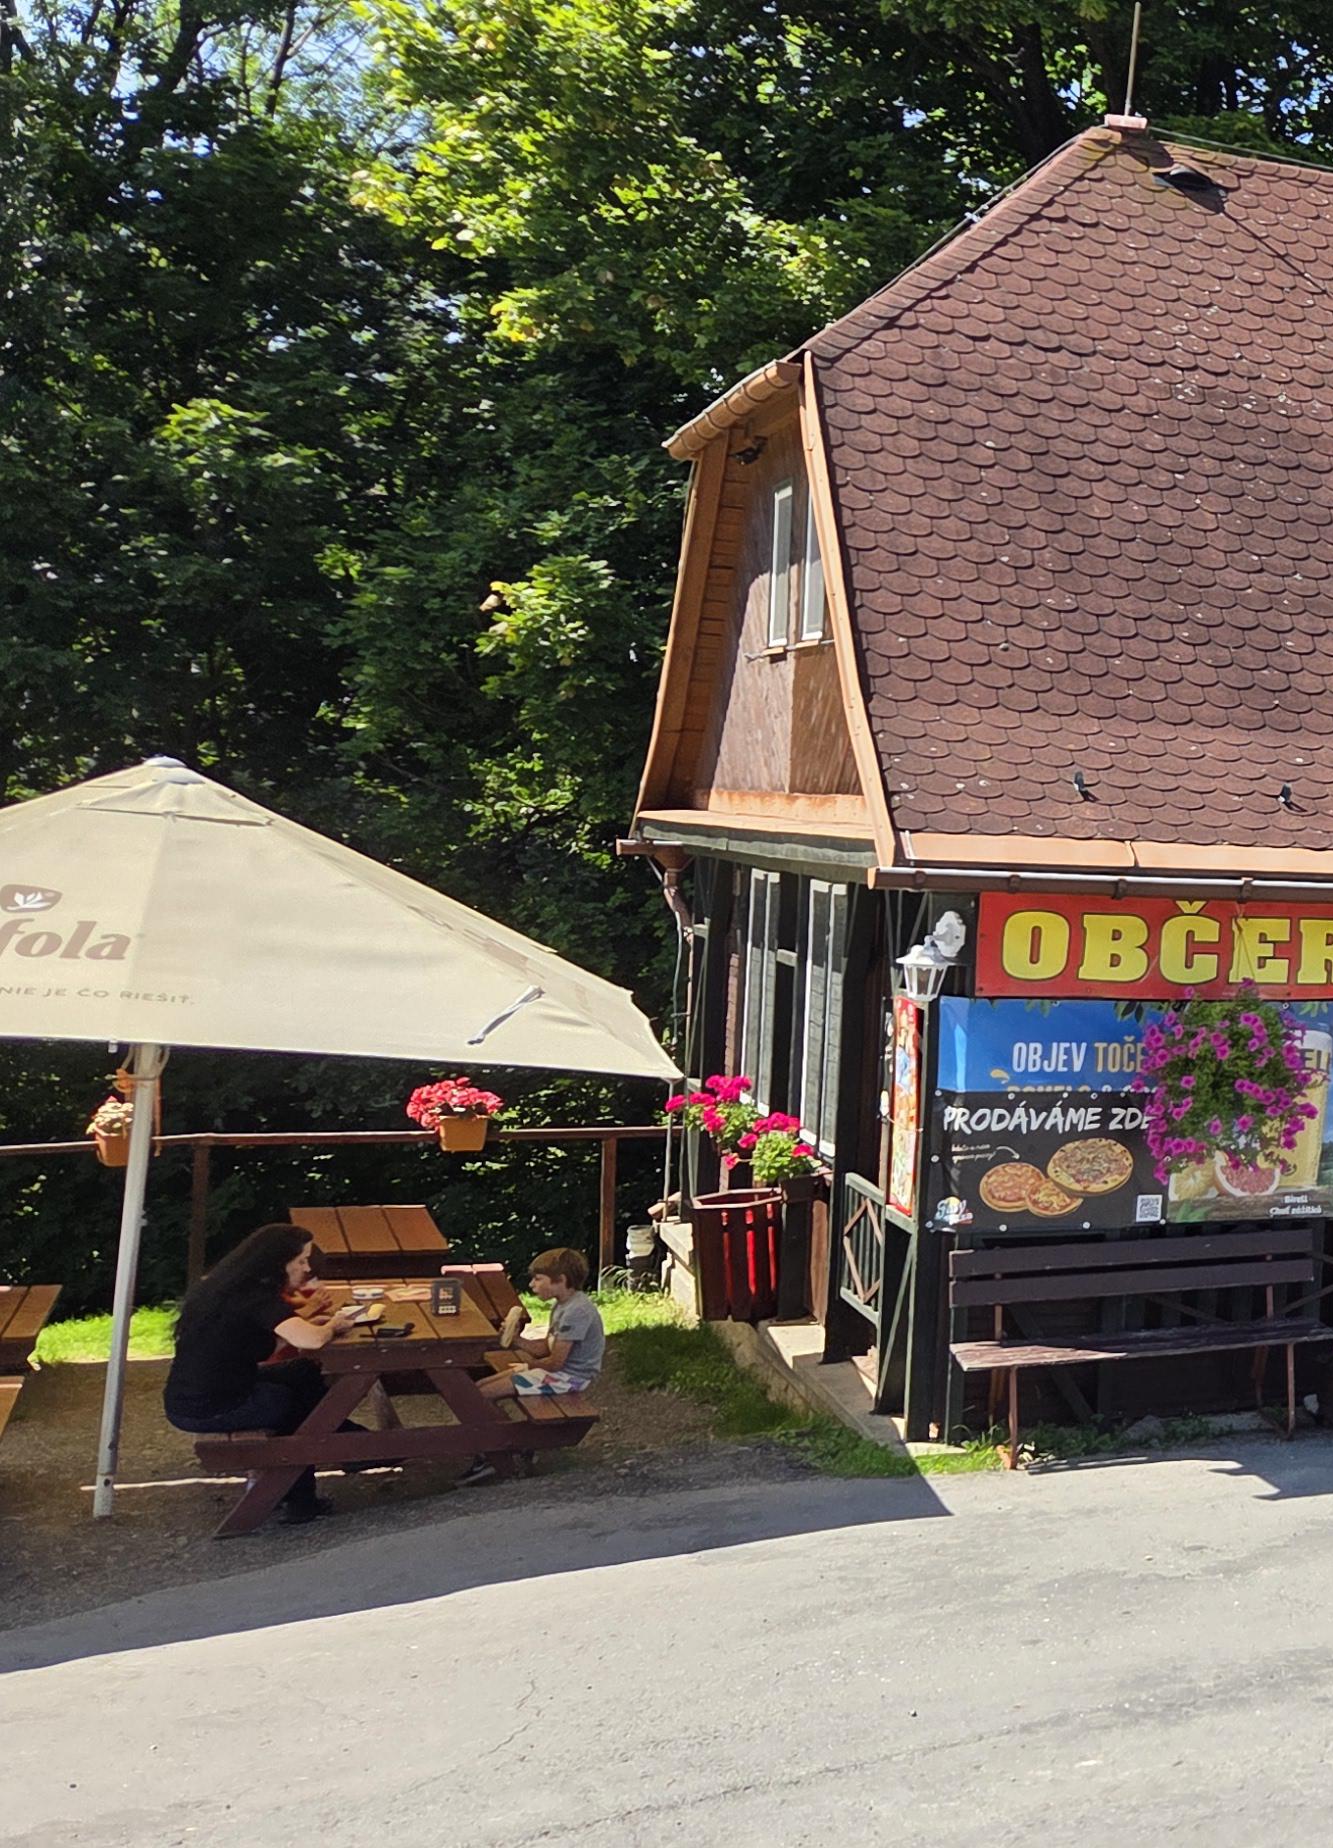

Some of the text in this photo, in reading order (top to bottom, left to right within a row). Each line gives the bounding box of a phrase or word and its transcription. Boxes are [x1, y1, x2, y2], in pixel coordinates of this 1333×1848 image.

[43, 987, 67, 998] JE
[77, 986, 109, 998] ČO
[1012, 1041, 1087, 1072] OBJEV
[943, 1101, 1103, 1134] PRODÁVÁME
